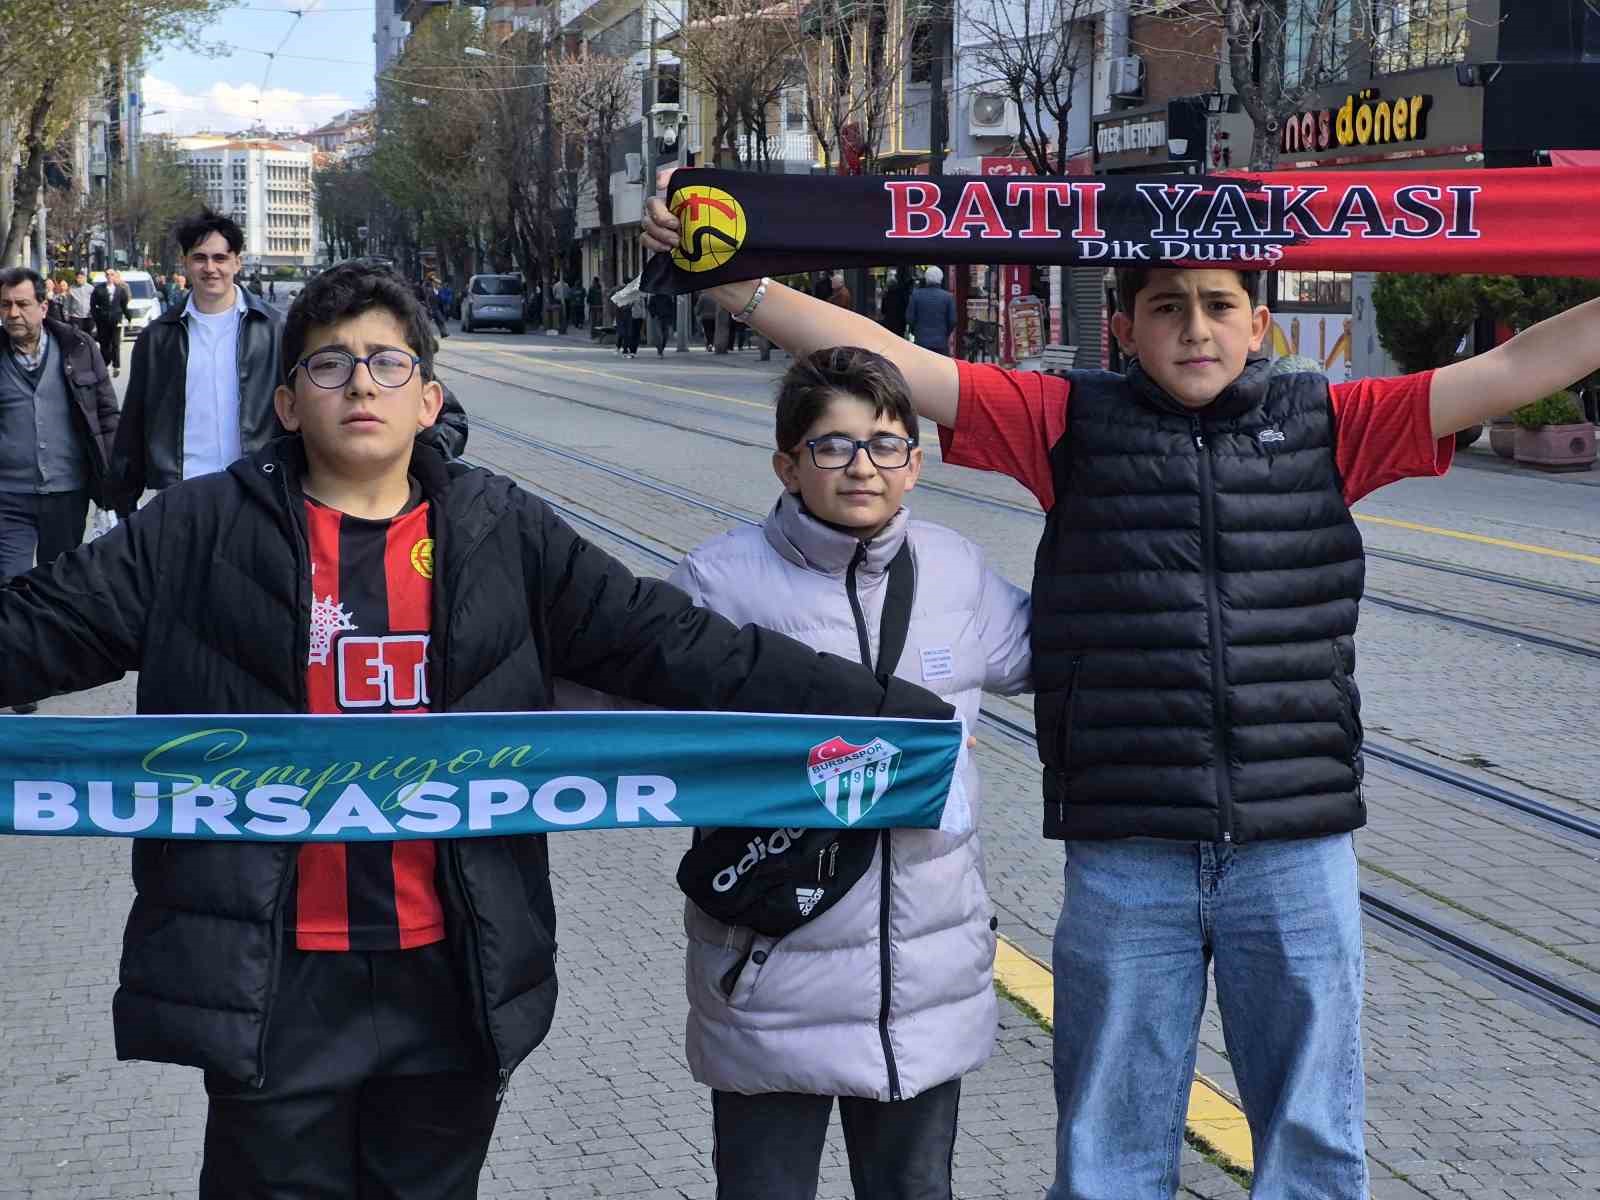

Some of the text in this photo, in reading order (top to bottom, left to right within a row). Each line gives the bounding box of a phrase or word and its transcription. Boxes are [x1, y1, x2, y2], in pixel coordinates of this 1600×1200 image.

[1336, 89, 1423, 146] döner
[884, 182, 1482, 239] BATI YAKASI
[1078, 240, 1284, 267] Dik Duruş
[811, 742, 883, 775] BURSASPOR
[842, 762, 887, 789] 1963
[13, 775, 682, 836] BURSASPOR
